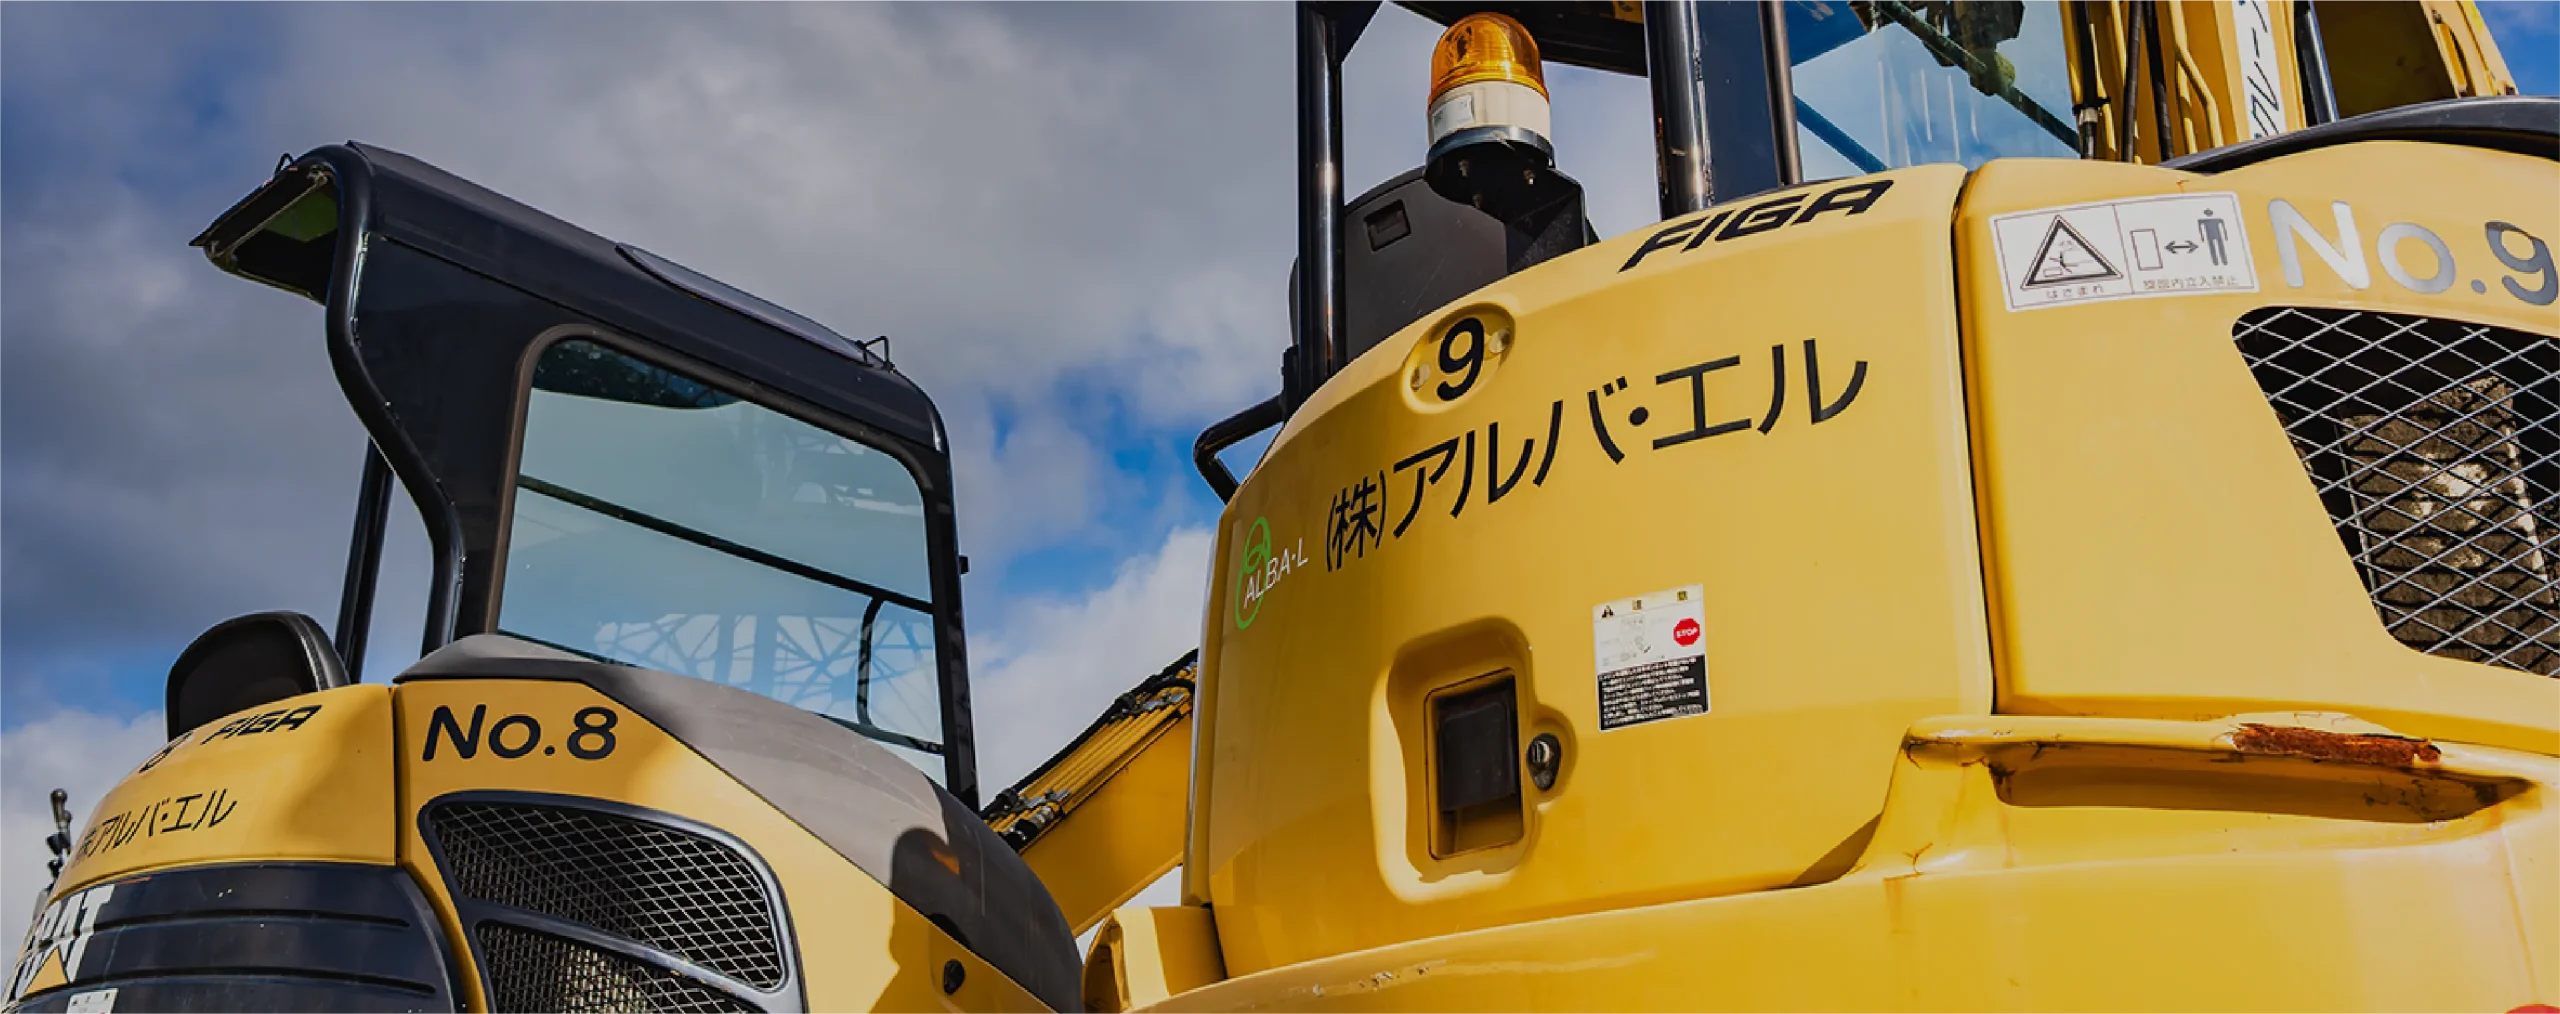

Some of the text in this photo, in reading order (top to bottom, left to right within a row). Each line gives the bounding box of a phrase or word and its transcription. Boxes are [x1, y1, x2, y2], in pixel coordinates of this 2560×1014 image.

[1617, 179, 1894, 274] FIGA
[2267, 198, 2559, 306] No.9
[1436, 317, 1485, 401] 9
[422, 704, 618, 762] No.8
